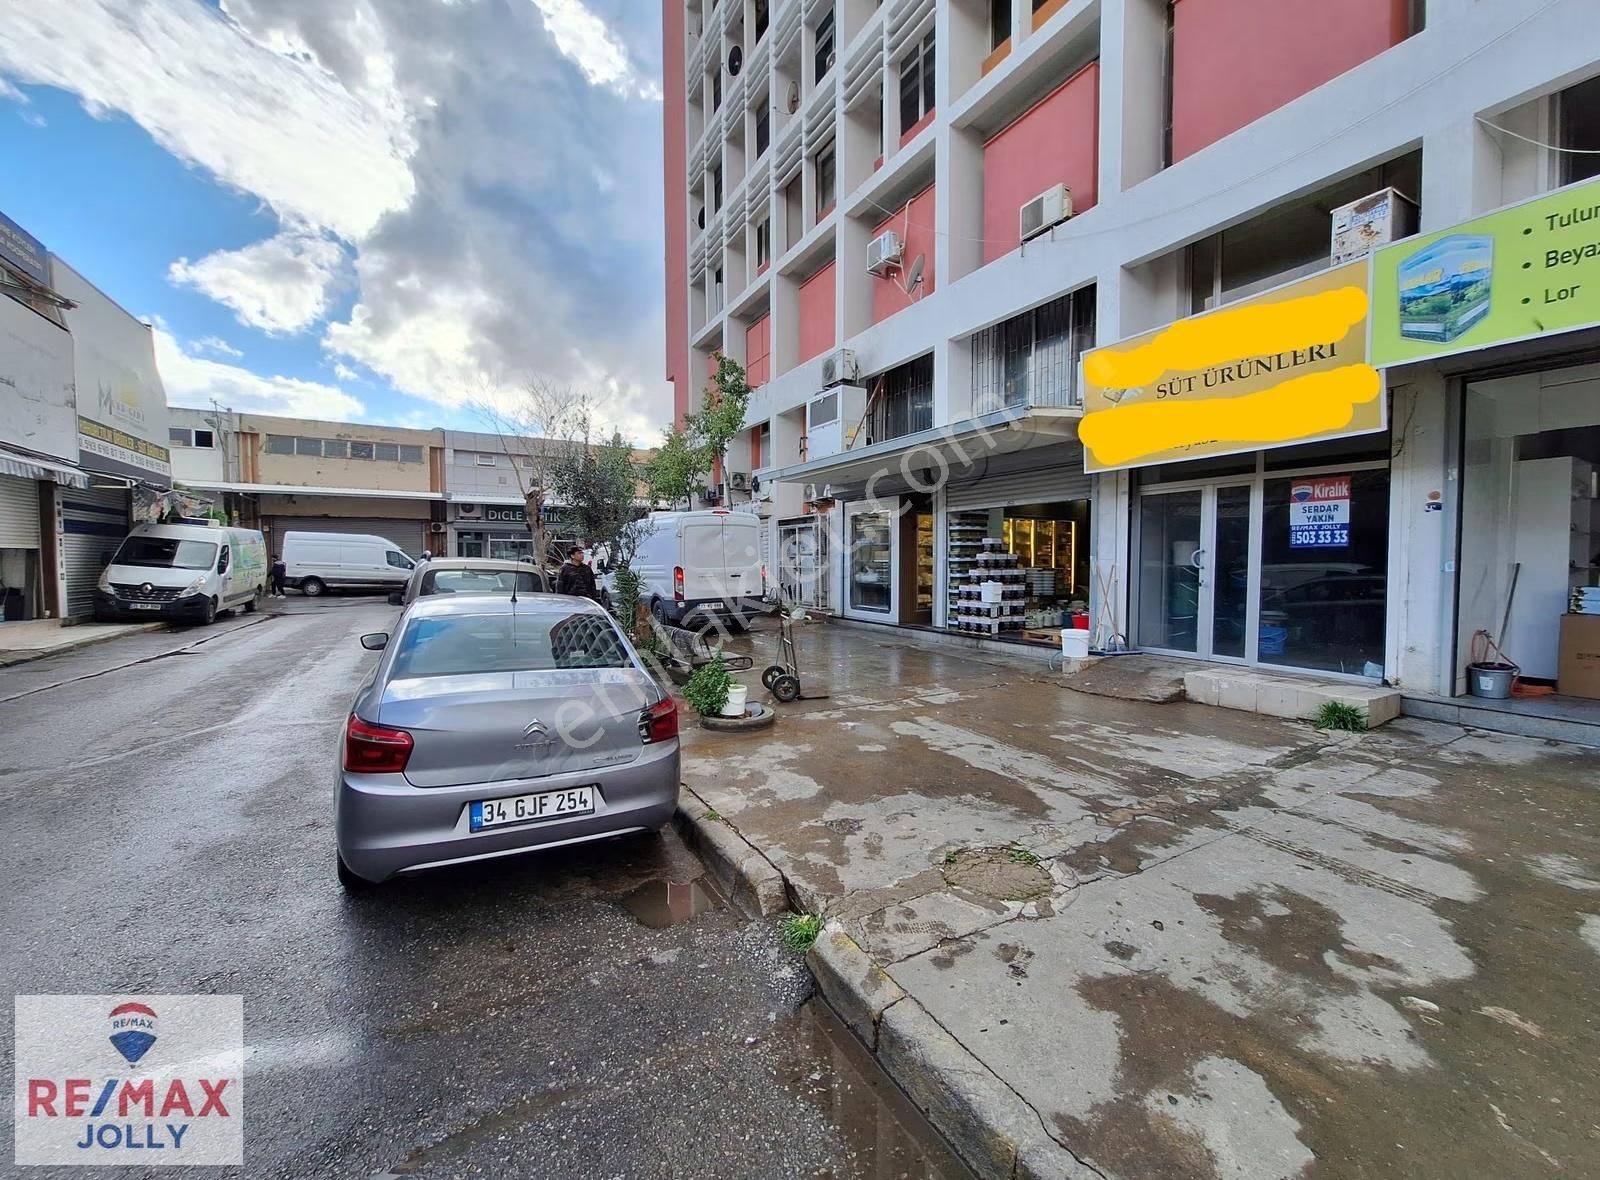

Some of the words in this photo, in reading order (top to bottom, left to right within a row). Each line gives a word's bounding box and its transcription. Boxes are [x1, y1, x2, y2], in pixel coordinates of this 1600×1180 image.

[1544, 285, 1581, 304] Lor
[1156, 375, 1198, 399] SÜT
[1302, 504, 1339, 514] SERDAR
[1306, 514, 1335, 523] YAKIN
[1296, 531, 1316, 544] 503
[1317, 530, 1331, 543] 33
[1333, 530, 1348, 543] 33
[484, 803, 507, 822] 34
[515, 796, 549, 818] GJF
[556, 792, 589, 812] 254
